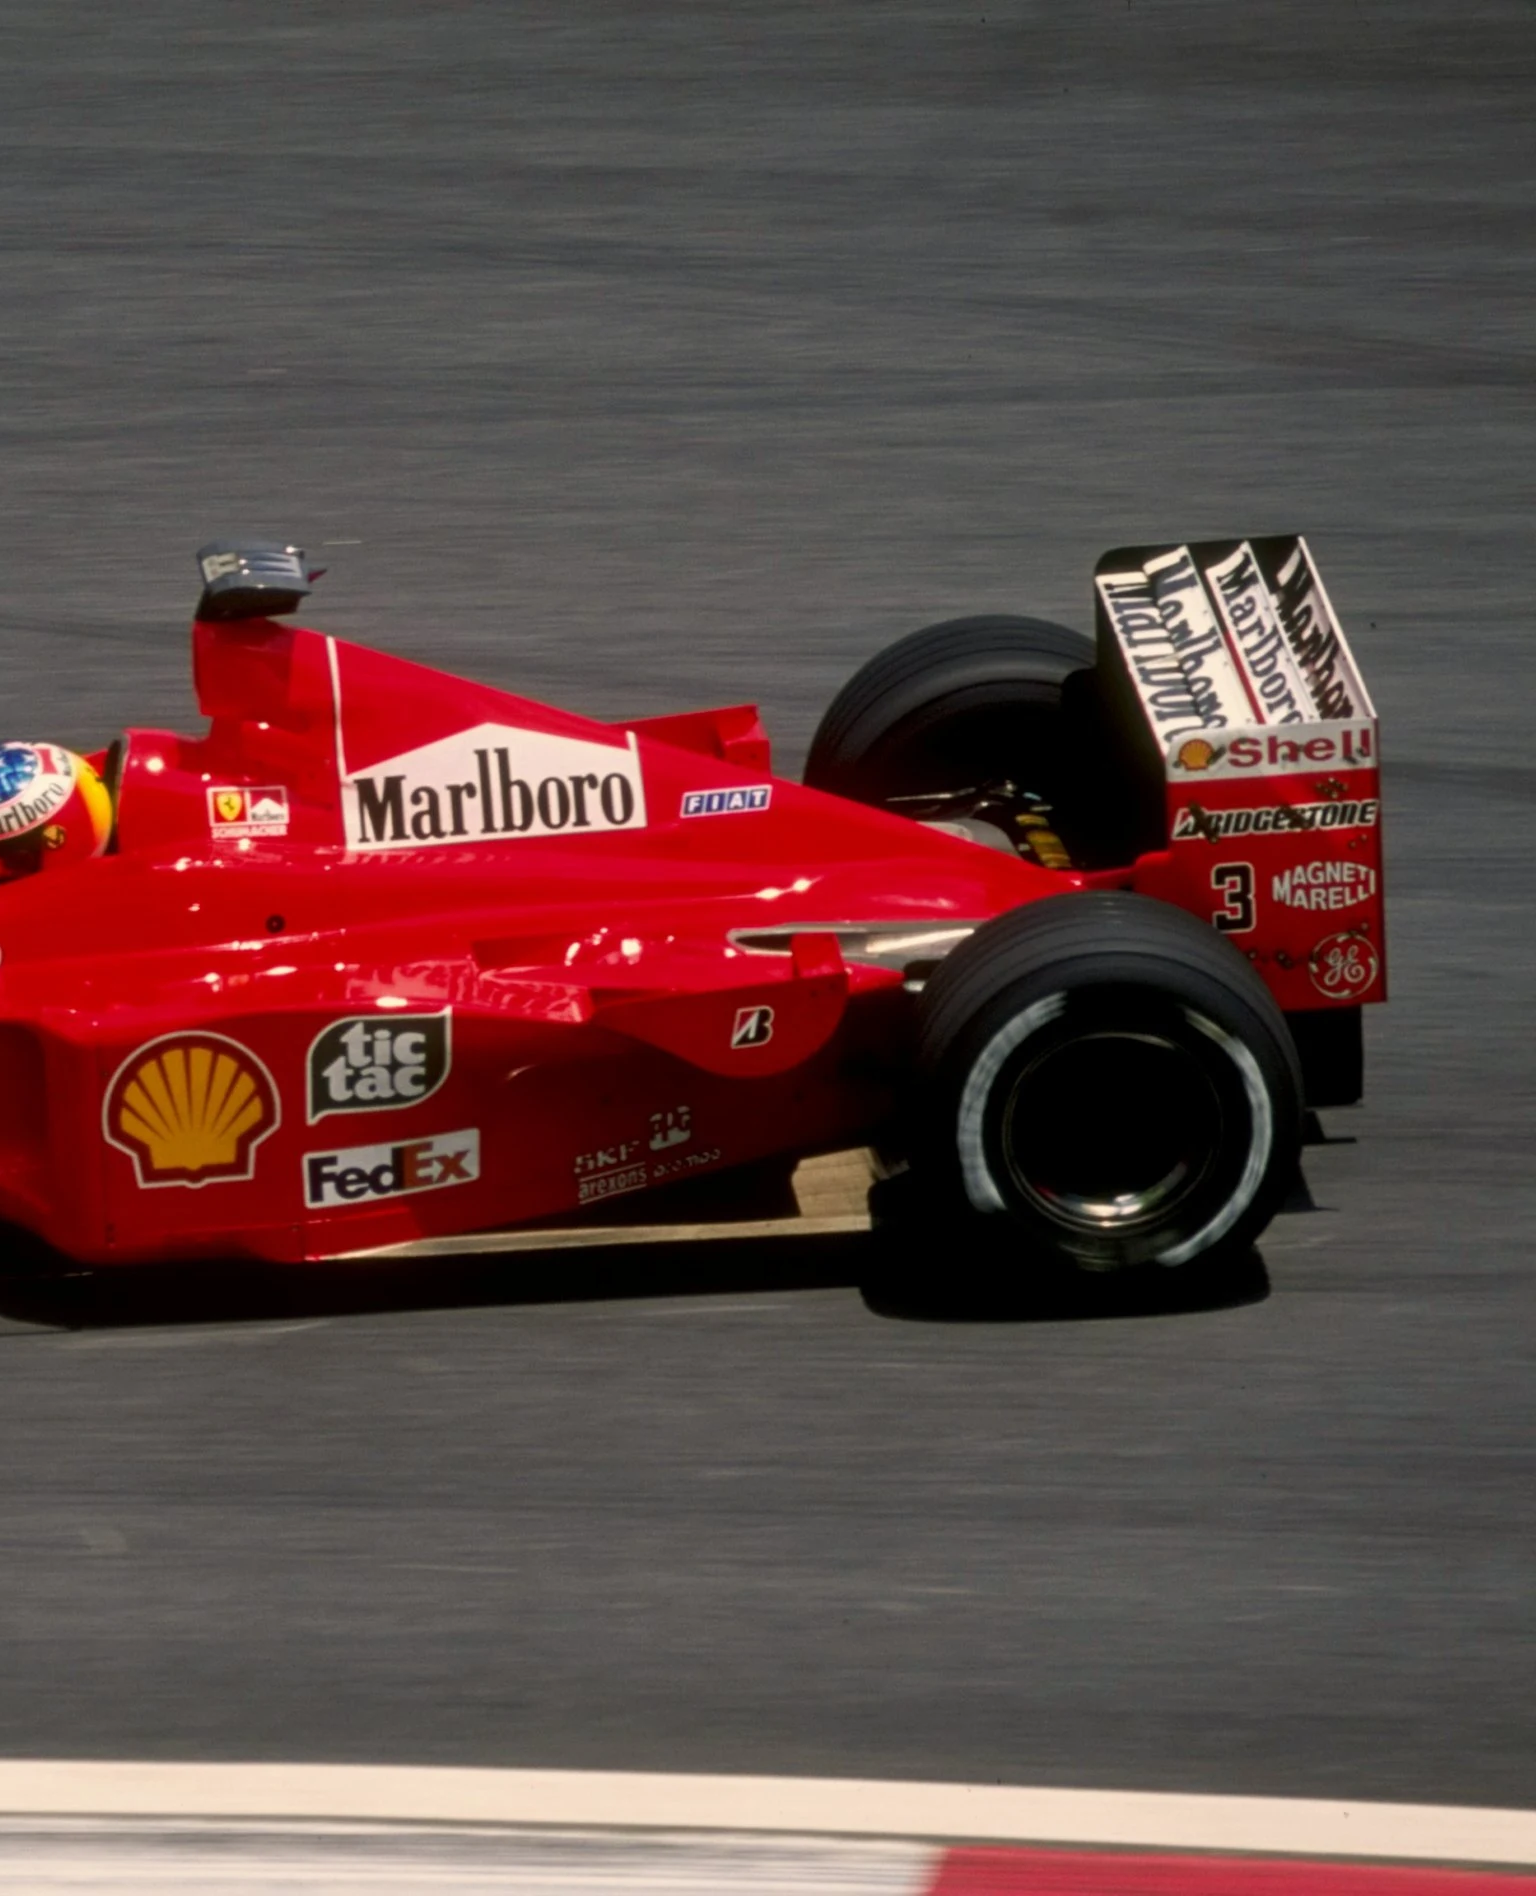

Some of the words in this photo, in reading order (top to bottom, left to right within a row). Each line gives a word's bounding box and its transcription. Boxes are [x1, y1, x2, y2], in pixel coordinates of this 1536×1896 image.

[1227, 728, 1371, 768] Shell
[353, 748, 634, 844] Marlboro
[684, 788, 768, 815] FIAT
[1272, 860, 1376, 892] MAGNETI
[1272, 878, 1376, 911] MARELLI
[1212, 862, 1255, 933] 3
[340, 1022, 426, 1067] tic
[322, 1056, 426, 1101] tac
[307, 1140, 473, 1204] FedEx
[577, 1167, 648, 1200] arexons
